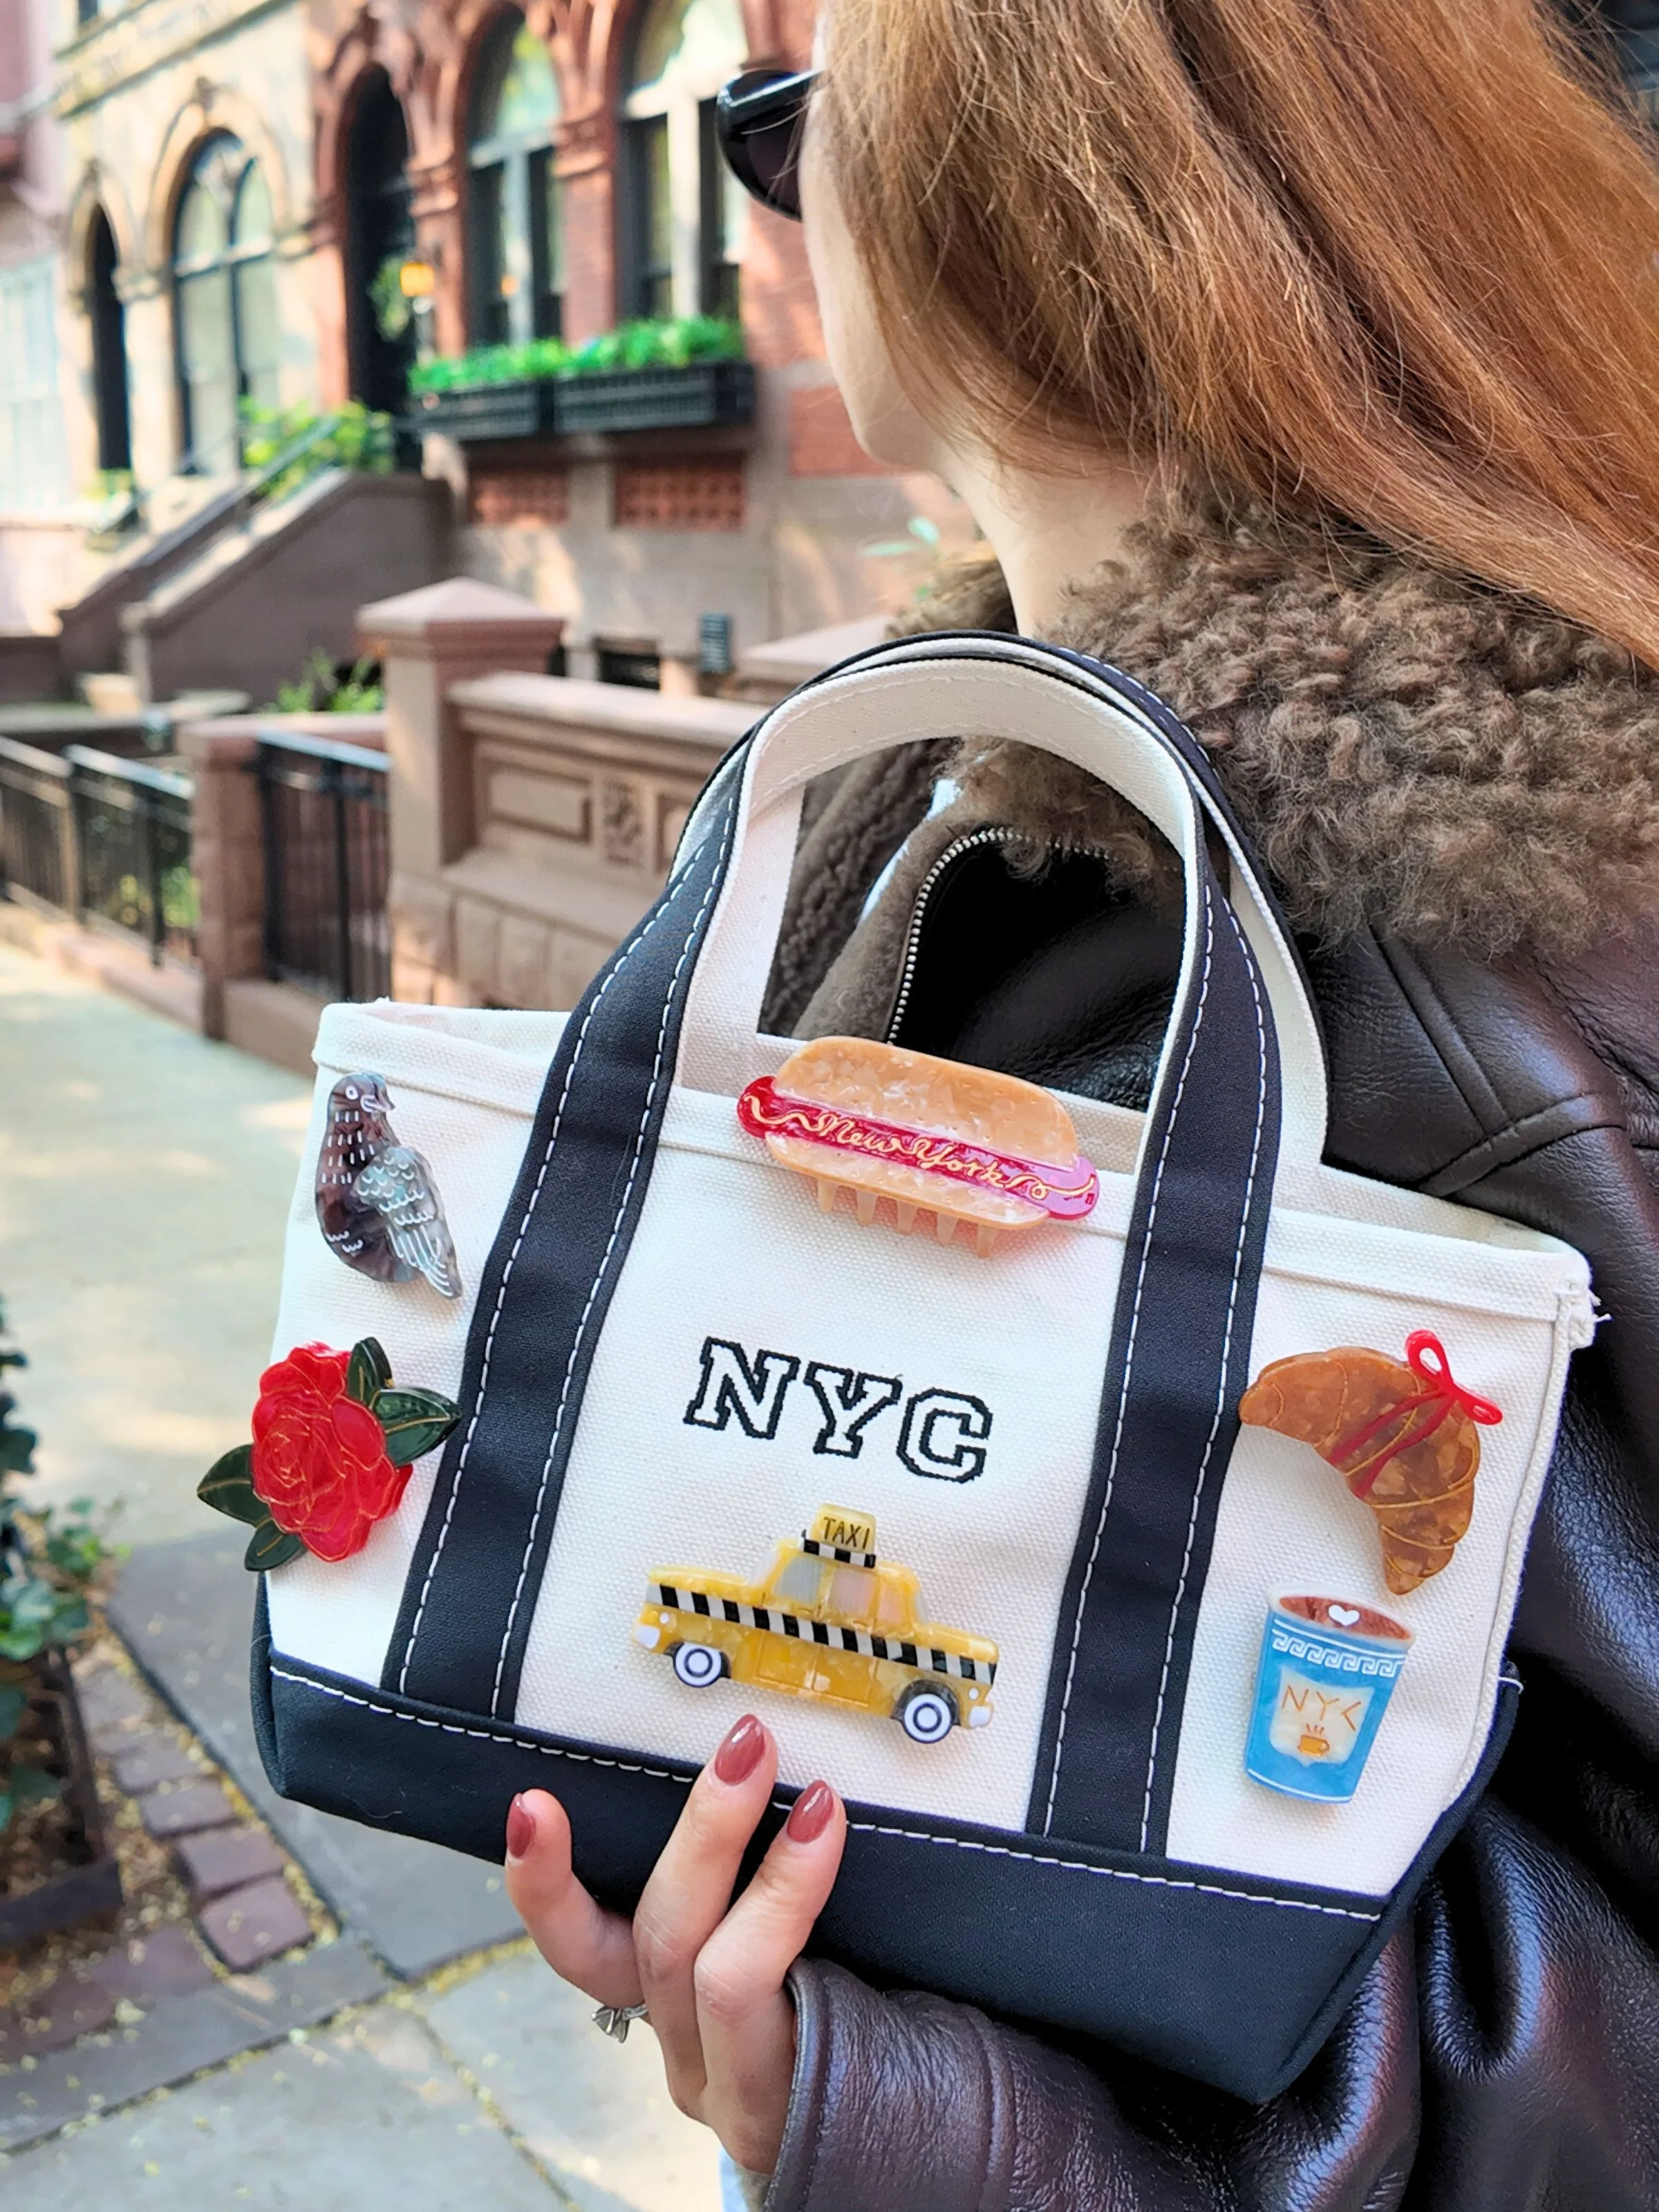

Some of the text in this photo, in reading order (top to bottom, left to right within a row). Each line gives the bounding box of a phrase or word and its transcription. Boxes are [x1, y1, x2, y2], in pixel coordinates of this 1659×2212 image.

[818, 1112, 1007, 1188] New York
[683, 1335, 994, 1483] NYC
[823, 1516, 871, 1550] TAXI
[1281, 1685, 1362, 1732] NYC
